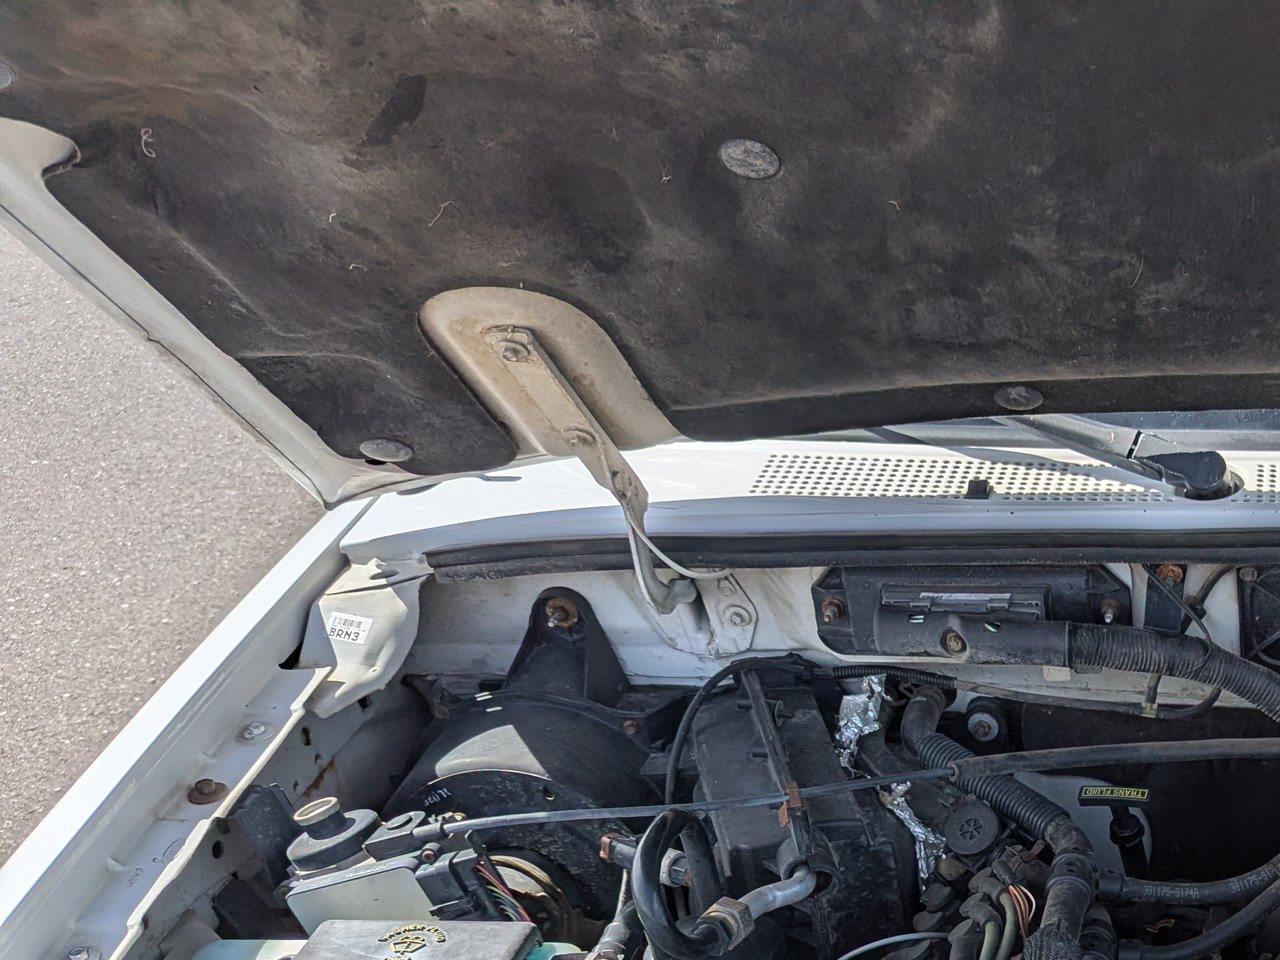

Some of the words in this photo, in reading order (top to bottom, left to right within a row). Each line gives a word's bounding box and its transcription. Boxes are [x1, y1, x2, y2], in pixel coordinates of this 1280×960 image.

[329, 627, 360, 641] BRN3
[1087, 788, 1111, 796] FLUID
[1114, 788, 1141, 798] TRANS
